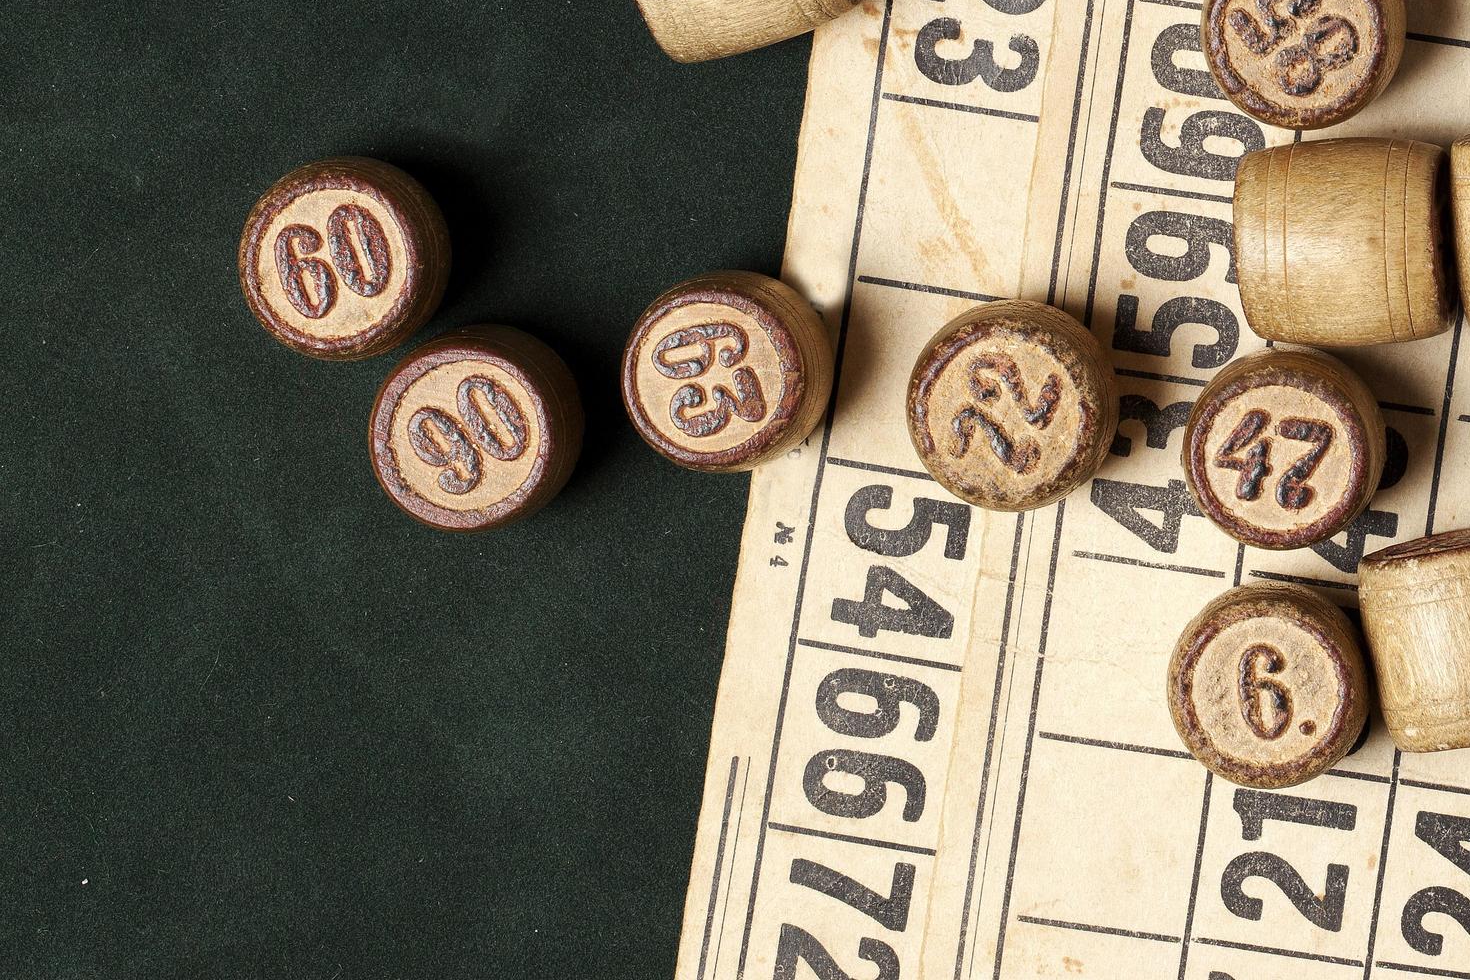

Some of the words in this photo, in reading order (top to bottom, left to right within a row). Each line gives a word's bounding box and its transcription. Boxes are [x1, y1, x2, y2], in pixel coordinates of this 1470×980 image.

[274, 203, 391, 319] 60
[1114, 211, 1240, 370] 59
[406, 374, 530, 495] 90
[651, 320, 767, 438] 63
[1213, 408, 1335, 510] 47
[831, 484, 971, 639] 54
[804, 668, 940, 822] 66
[773, 858, 916, 980] 72
[1221, 788, 1357, 932] 21
